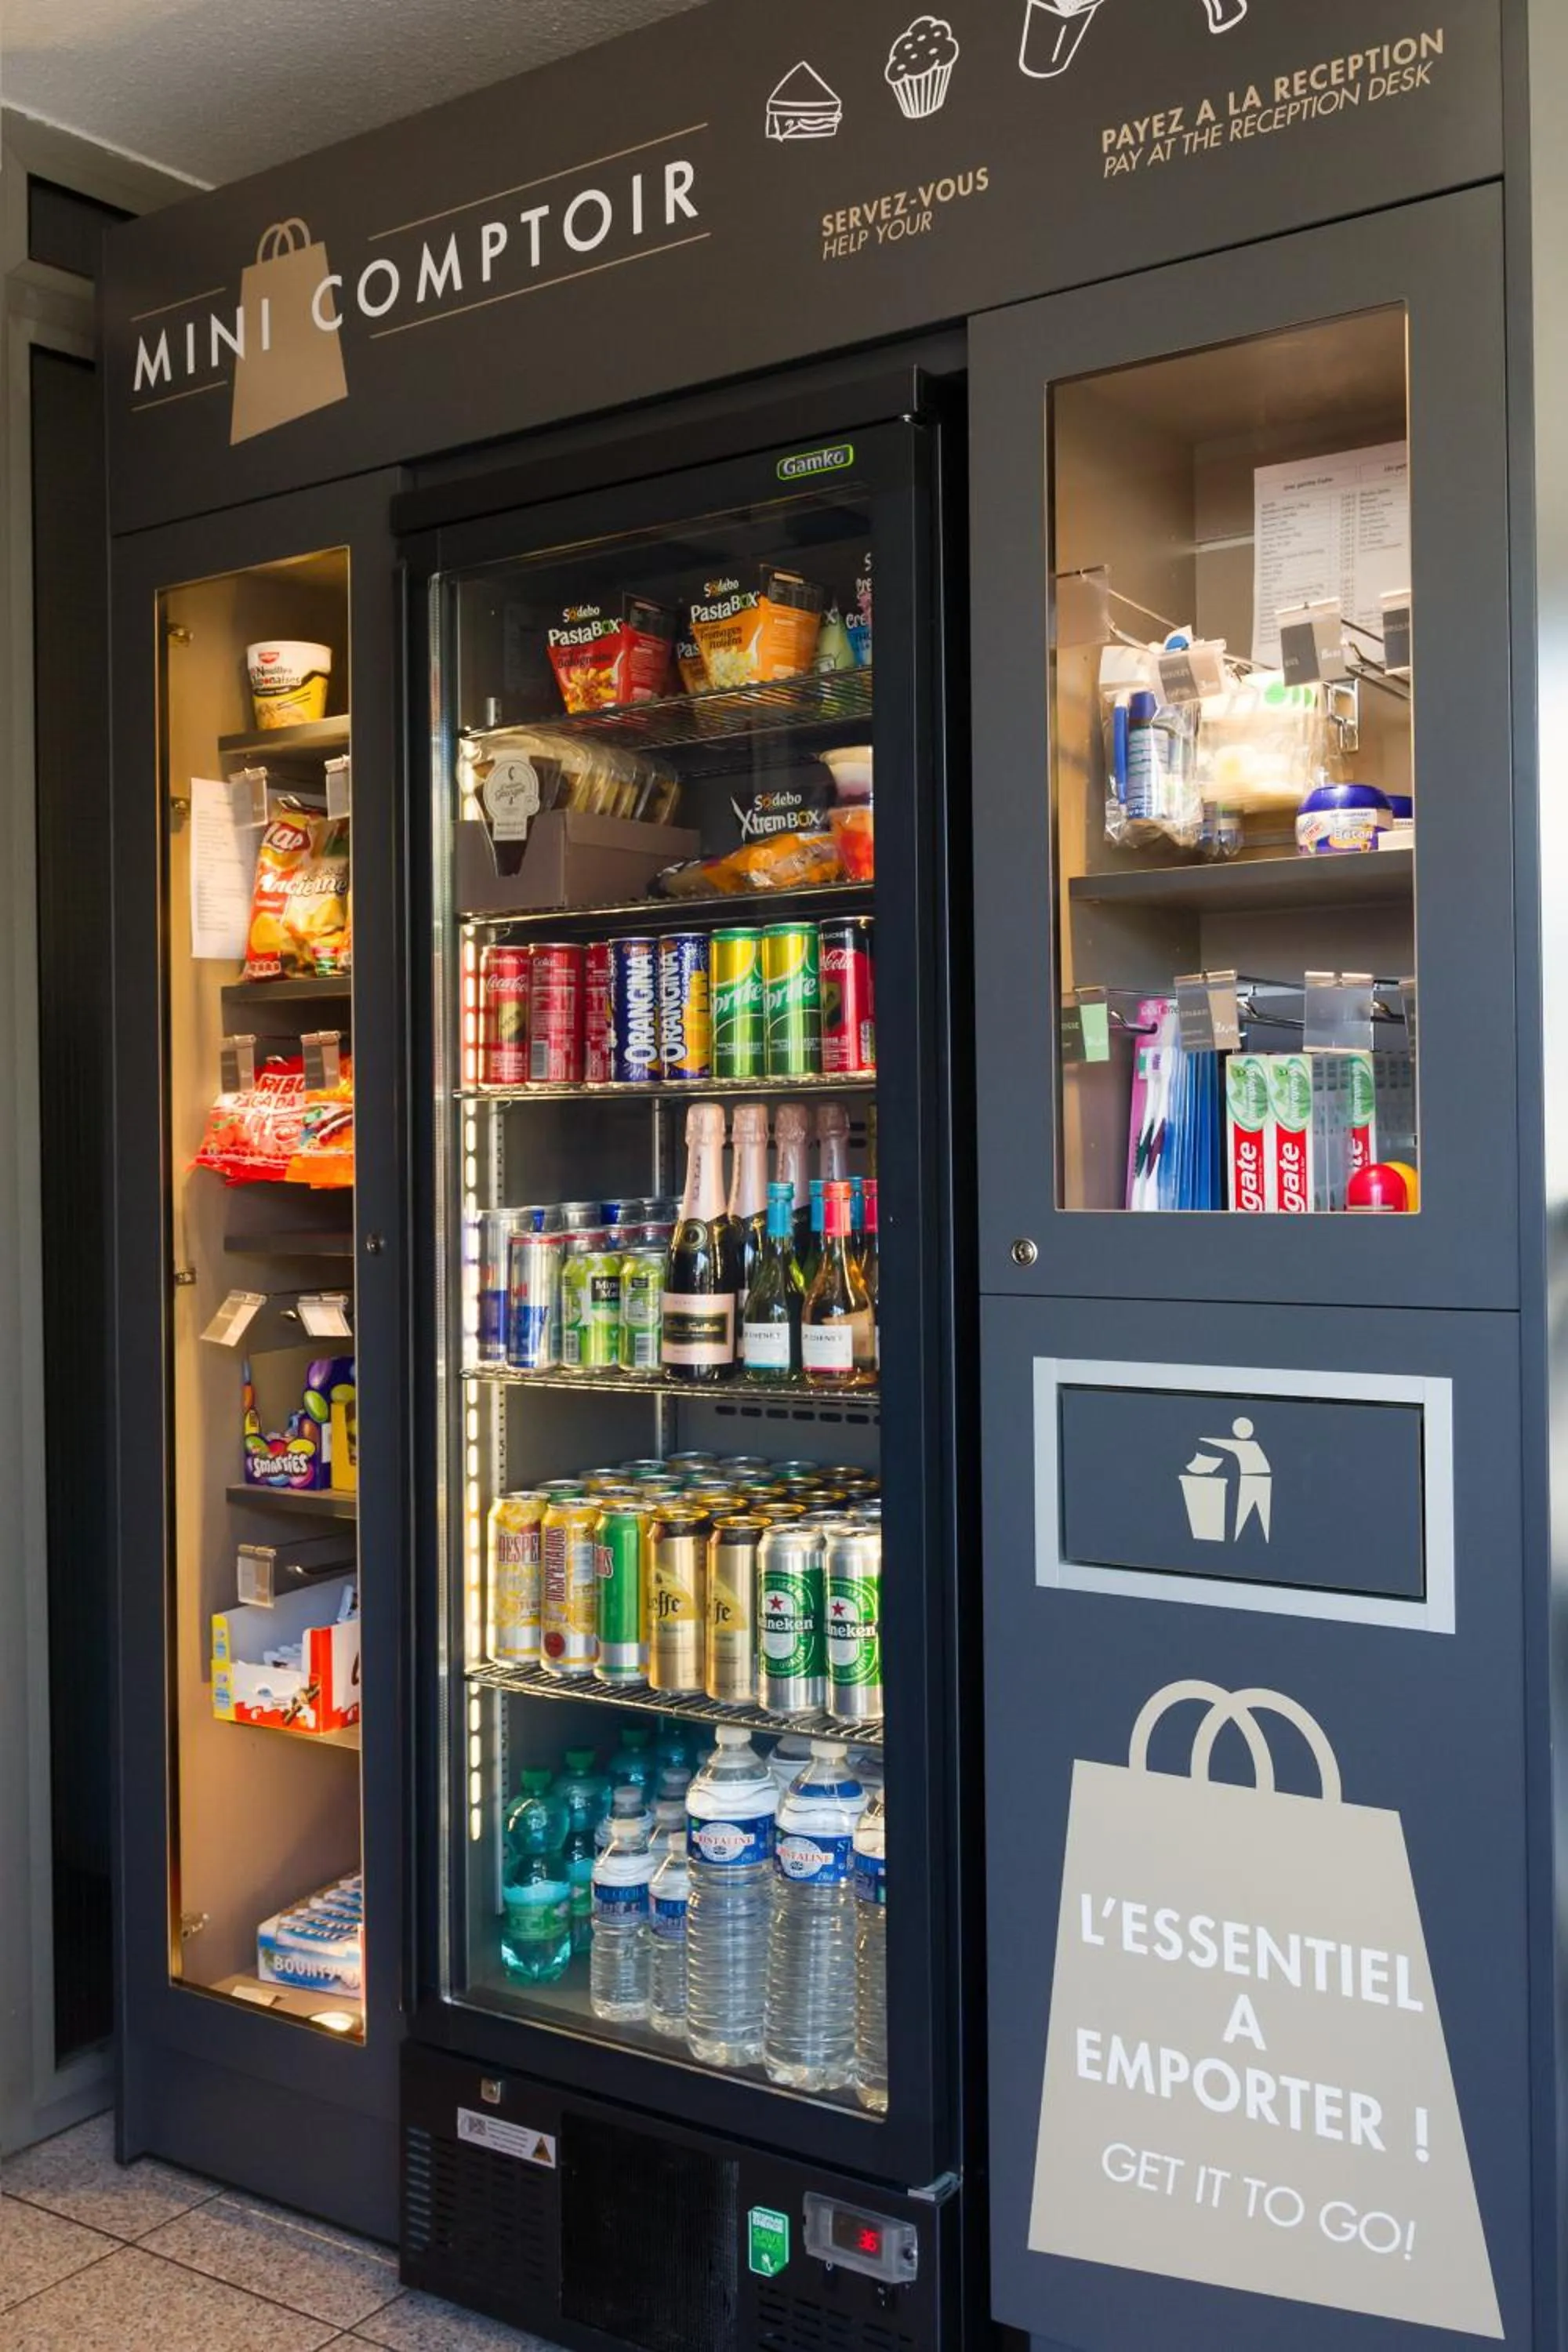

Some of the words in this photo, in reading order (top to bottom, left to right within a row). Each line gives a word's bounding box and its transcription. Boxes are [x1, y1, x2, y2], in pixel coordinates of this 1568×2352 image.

[1102, 108, 1183, 154] PAYEZ
[1197, 100, 1216, 125] A
[1228, 87, 1262, 117] LA
[1274, 28, 1446, 103] RECEPTION
[1103, 149, 1142, 179] PAY
[1148, 138, 1178, 166] AT
[1183, 126, 1223, 157] THE
[1229, 84, 1362, 144] RECEPTION
[1367, 61, 1434, 103] DESK
[821, 167, 990, 238] SERVEZ-VOUS
[822, 228, 869, 261] HELP
[874, 210, 933, 248] YOUR
[133, 299, 270, 392] MINI
[311, 160, 699, 332] COMPTOIR
[782, 450, 844, 475] Gamko
[624, 954, 658, 1065] ORANGINA
[660, 951, 687, 1064] ORANGINA
[713, 978, 763, 1014] prite
[766, 972, 816, 1010] prite
[1080, 1893, 1424, 2013] L'ESSENTIEL
[1222, 1994, 1267, 2052] A
[1076, 2027, 1386, 2152] EMPORTER
[1414, 2106, 1430, 2163] !
[1102, 2143, 1185, 2195] GET
[1196, 2165, 1231, 2208] IT
[1243, 2176, 1305, 2227] TO
[1319, 2201, 1417, 2261] GO!
